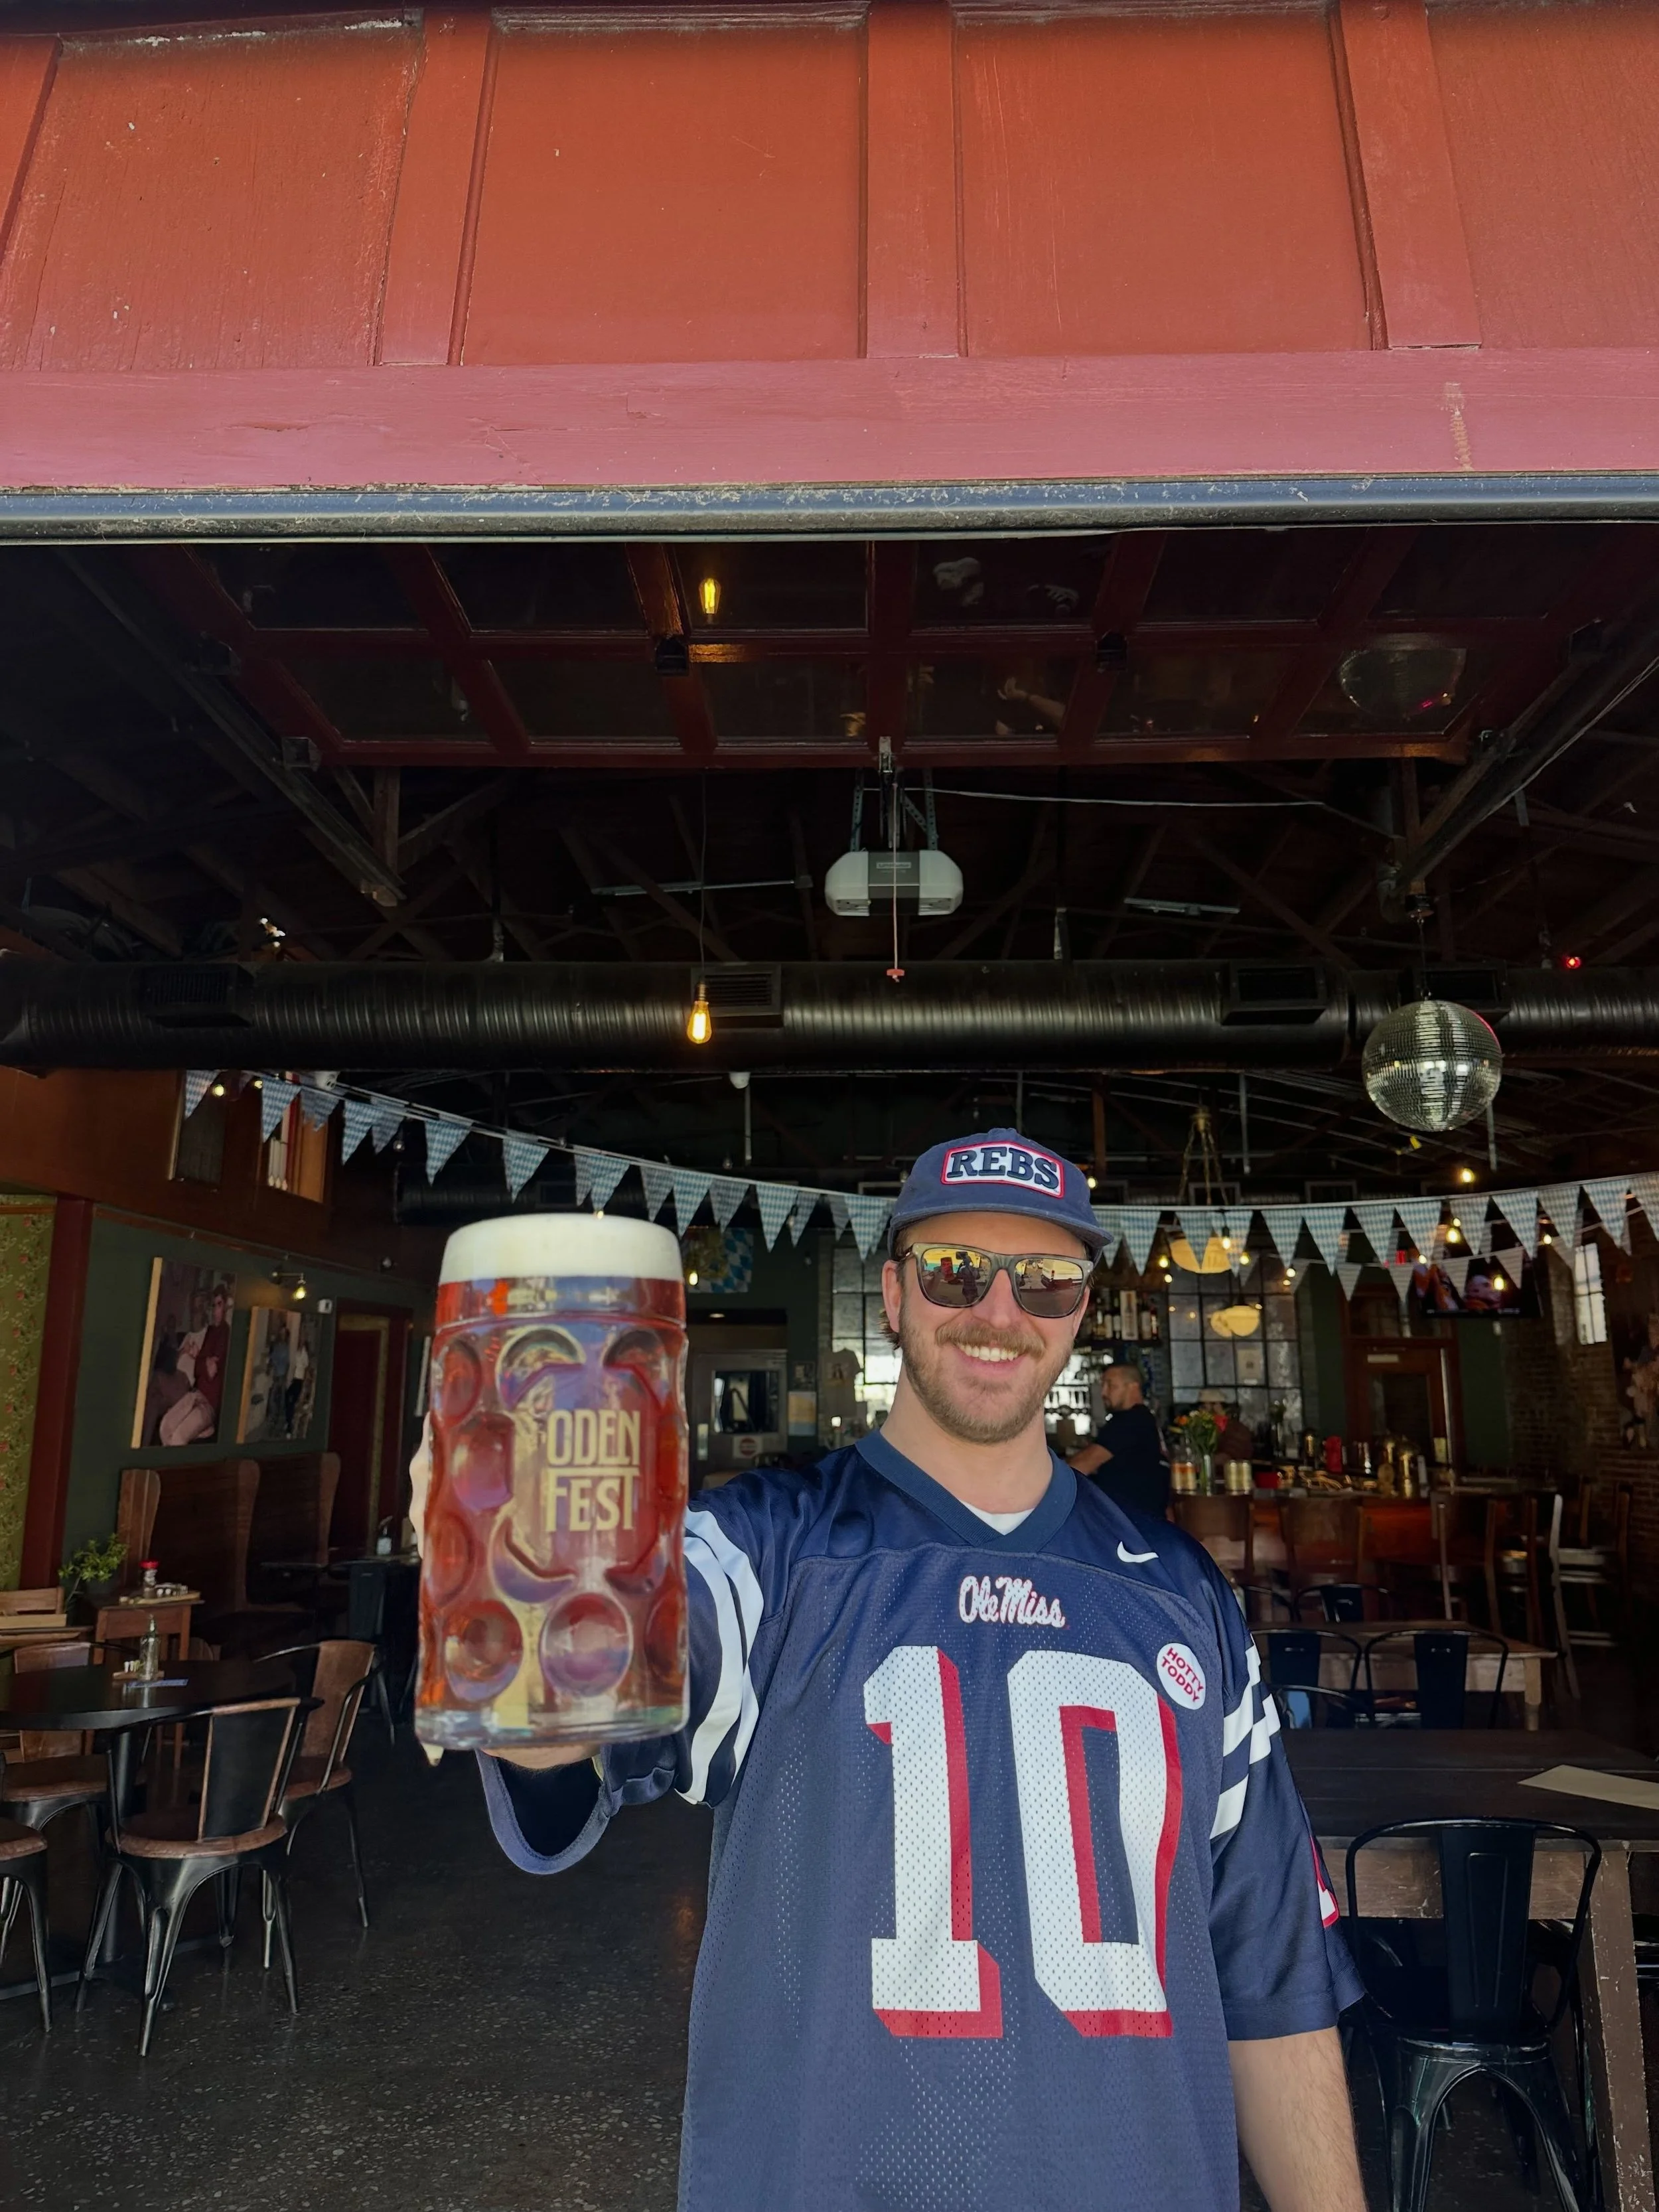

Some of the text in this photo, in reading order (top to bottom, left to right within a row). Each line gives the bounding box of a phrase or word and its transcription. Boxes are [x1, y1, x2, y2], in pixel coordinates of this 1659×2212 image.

[946, 1147, 1059, 1189] REBS
[546, 1408, 641, 1465] ODEN
[545, 1467, 640, 1532] FEST
[960, 1576, 1066, 1628] Ole Miss
[1161, 1656, 1200, 1702] TODDY
[1167, 1647, 1204, 1692] HOTTY
[863, 1645, 1183, 2037] 10
